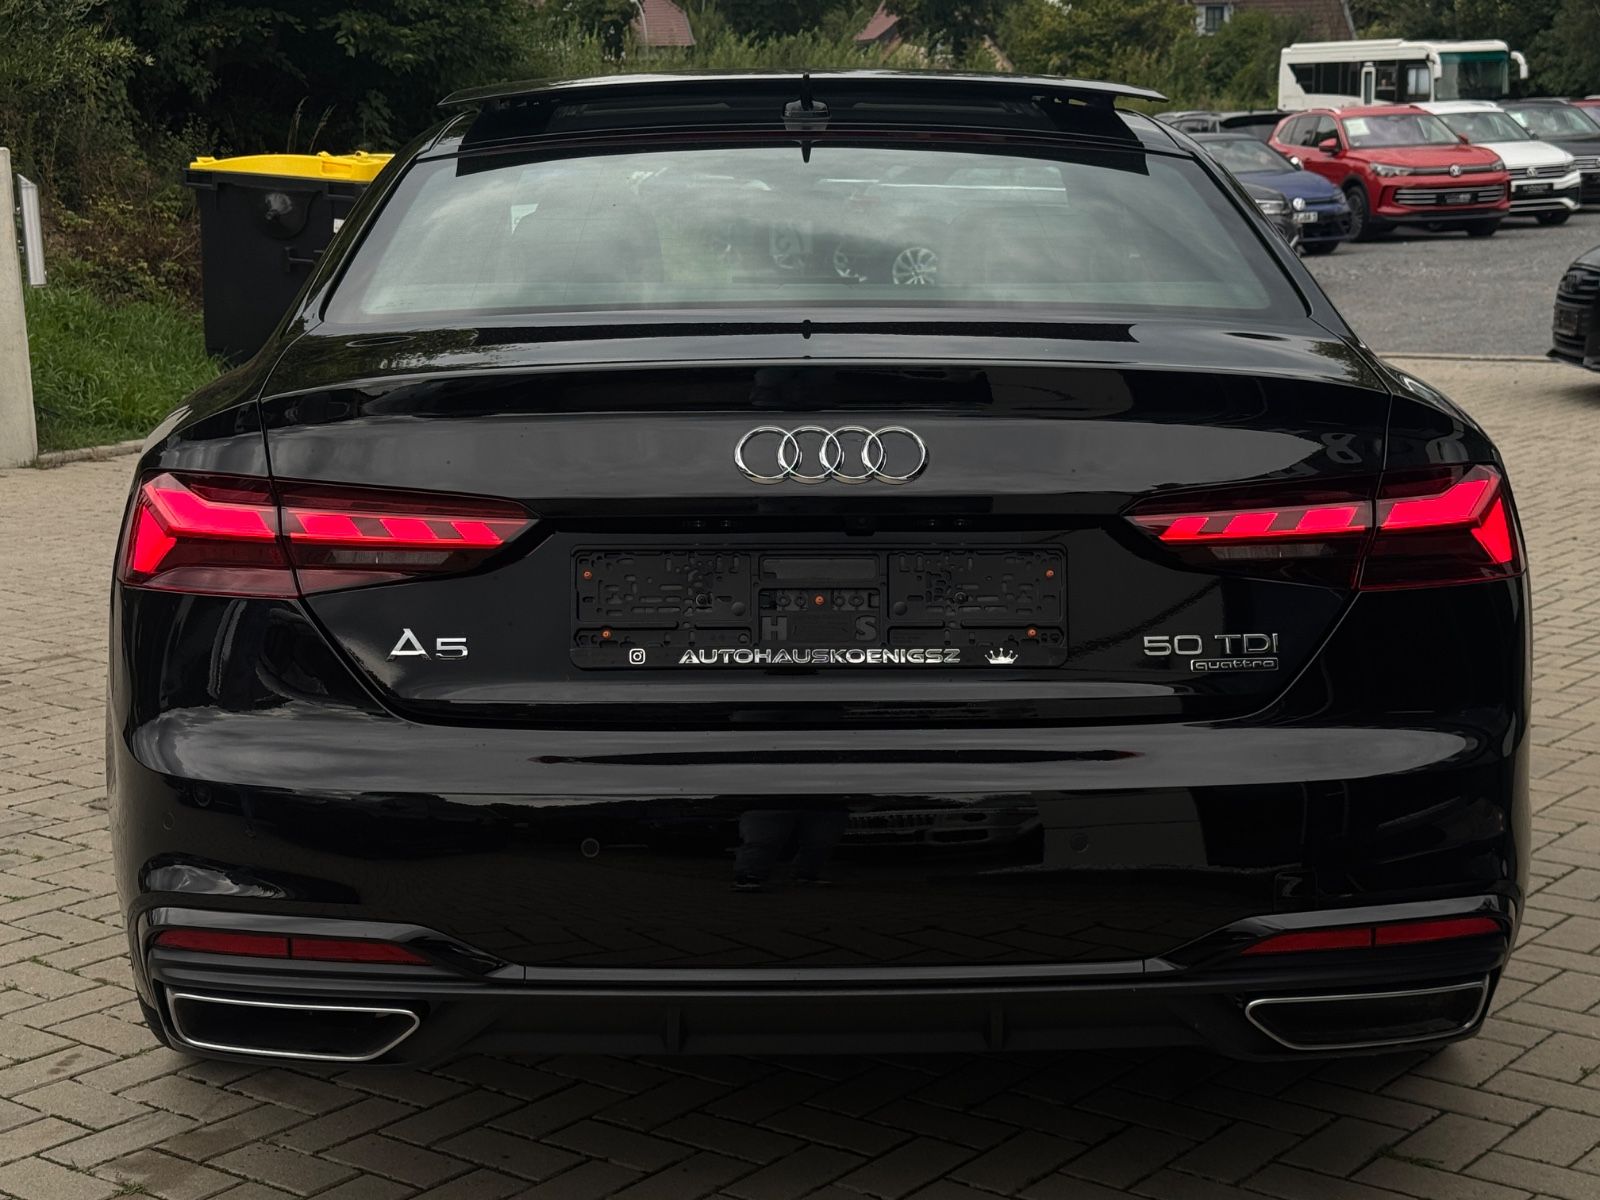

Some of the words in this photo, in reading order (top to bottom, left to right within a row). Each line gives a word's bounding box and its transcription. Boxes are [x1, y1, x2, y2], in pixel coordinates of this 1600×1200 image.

[385, 628, 468, 661] A5
[1143, 635, 1202, 656] 50
[1214, 633, 1279, 654] TDI
[679, 648, 961, 664] AUTOHAUSKOENIGSZ
[1195, 659, 1275, 670] quattro
